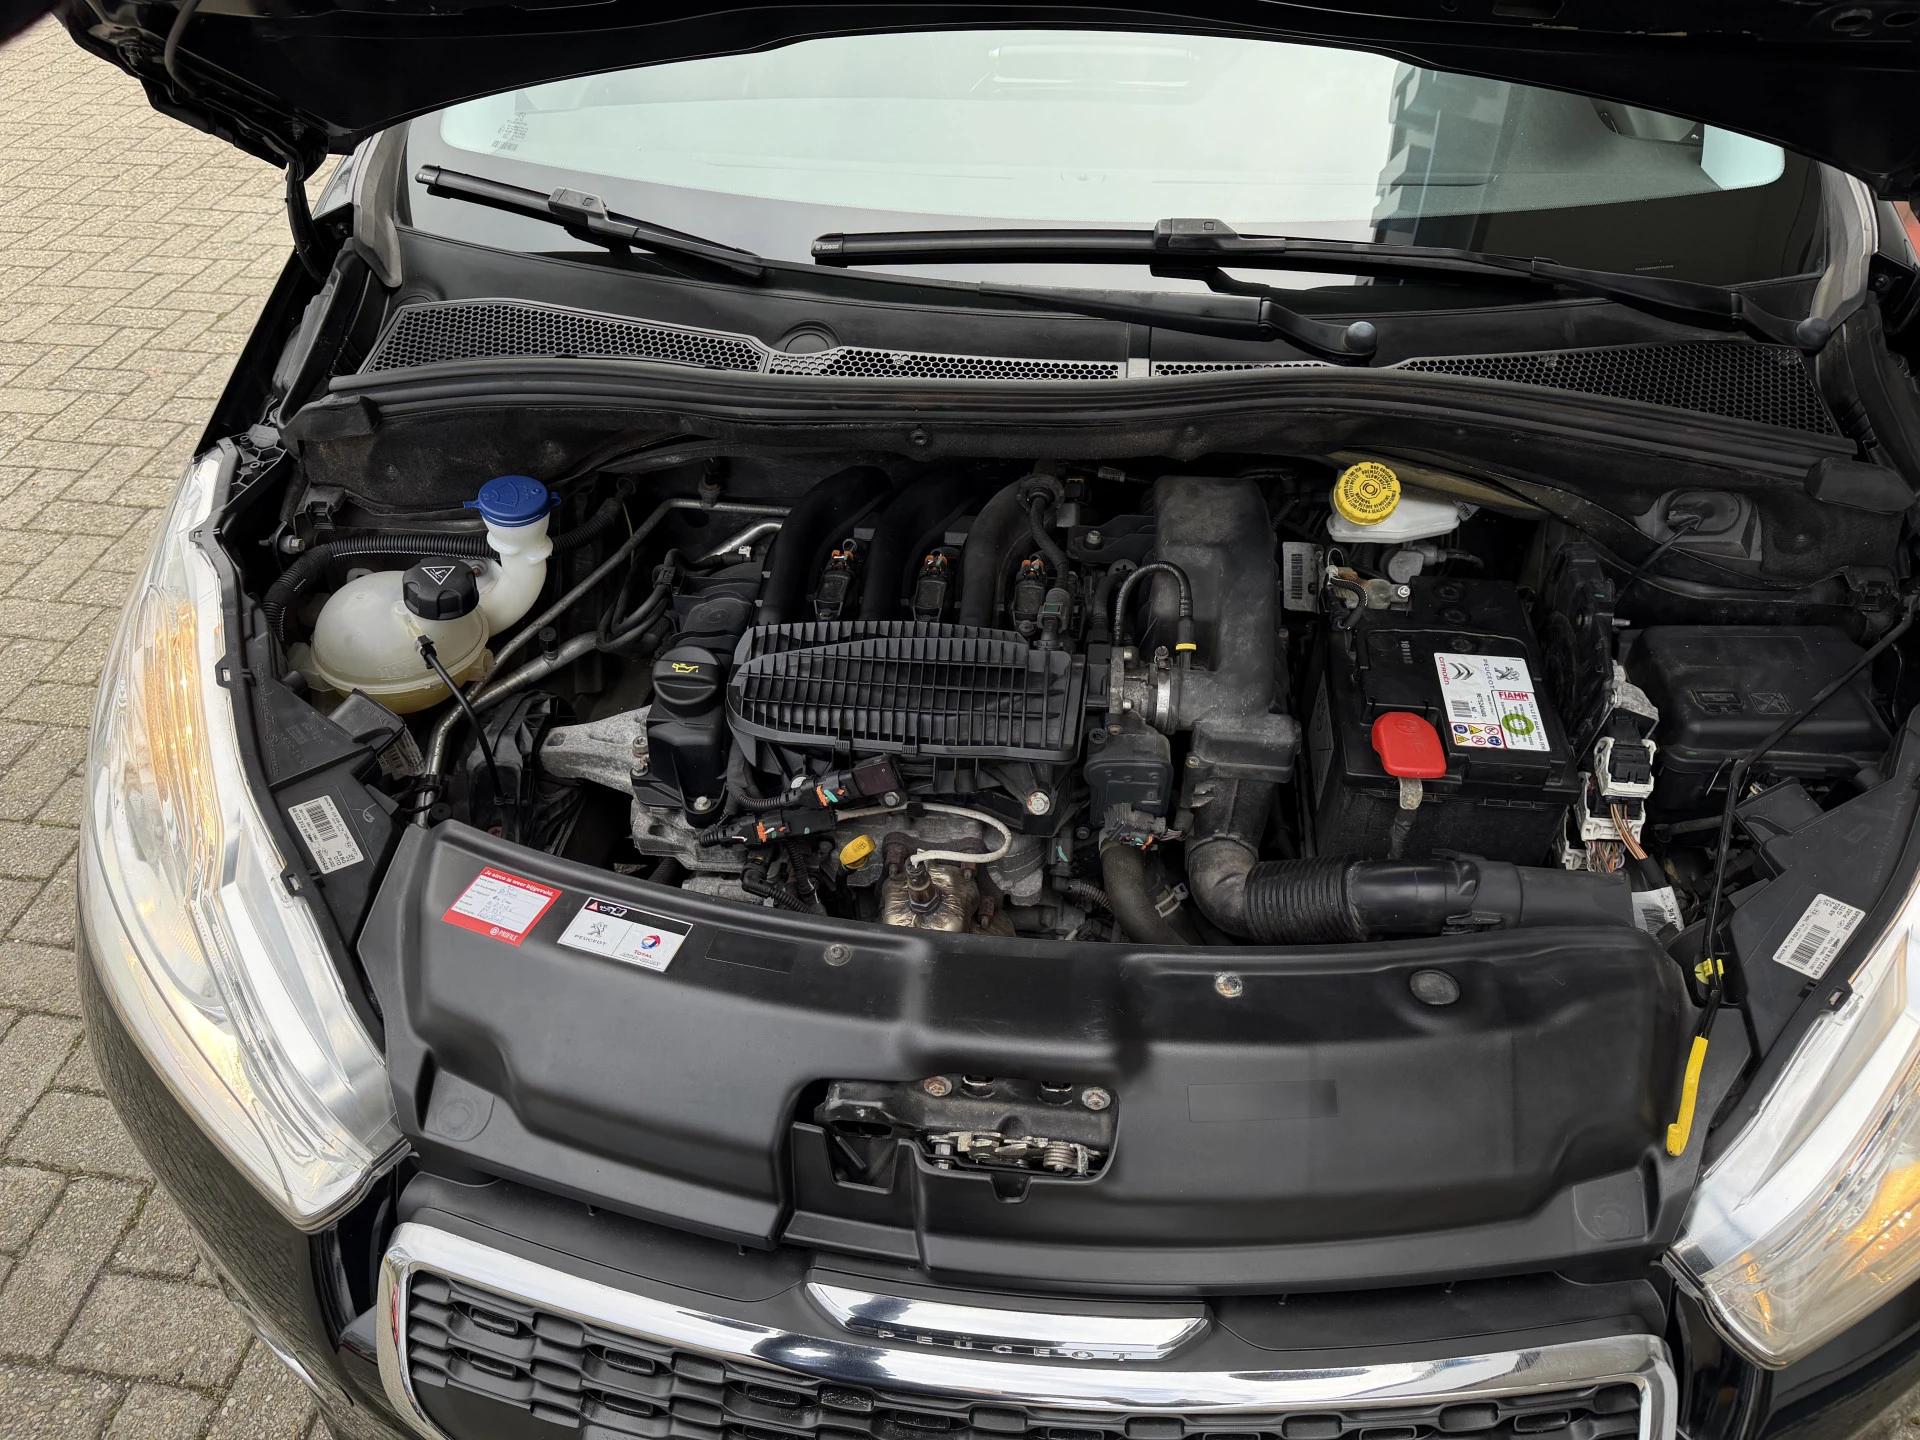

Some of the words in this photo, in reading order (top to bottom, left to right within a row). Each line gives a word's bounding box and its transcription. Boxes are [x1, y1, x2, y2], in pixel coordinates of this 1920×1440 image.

[1483, 658, 1495, 689] PEUGEOT
[1498, 691, 1529, 700] FIAMM
[492, 872, 507, 881] airco
[512, 879, 527, 888] weer
[526, 882, 554, 897] bijgevuld.
[498, 930, 518, 942] PROFILE
[573, 934, 607, 946] PEUGEOT
[634, 949, 653, 959] TOTAL
[877, 1329, 1132, 1362] PEUGEOT
